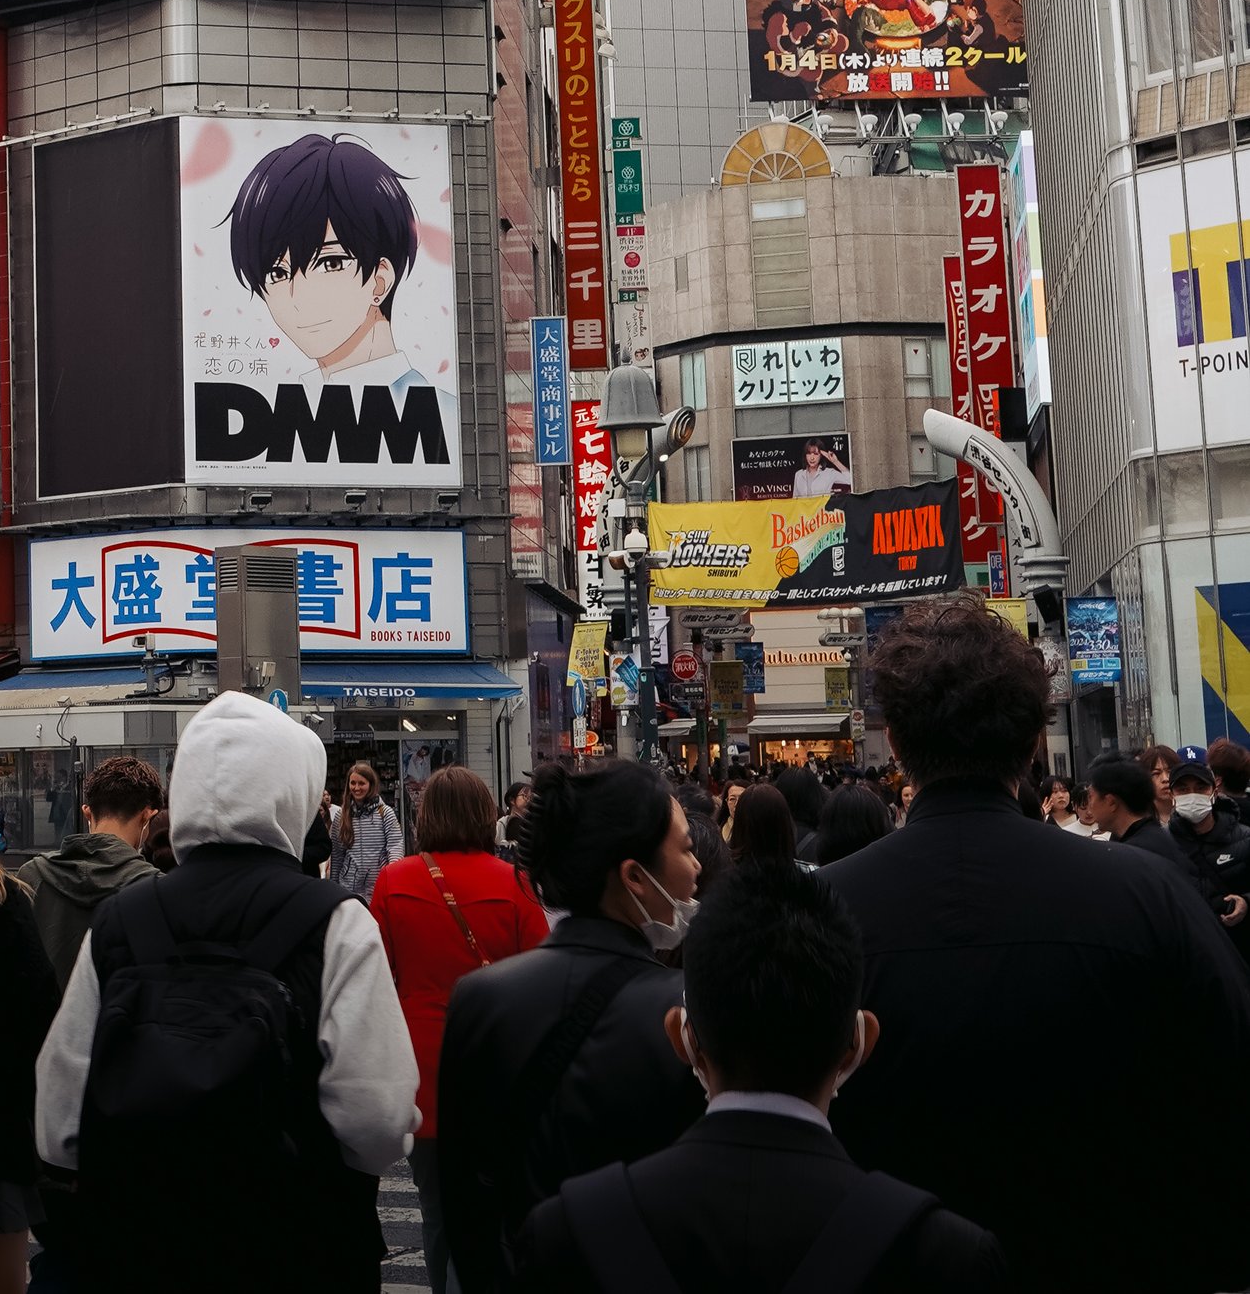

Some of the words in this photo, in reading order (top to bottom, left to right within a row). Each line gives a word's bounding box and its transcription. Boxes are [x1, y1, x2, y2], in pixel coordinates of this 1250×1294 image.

[618, 216, 632, 224] 4F
[964, 189, 1006, 362] カラオケ
[567, 220, 605, 352] 三千里
[623, 293, 635, 301] 3F
[205, 357, 268, 376] 恋の病
[762, 345, 840, 371] れいわ
[540, 326, 562, 458] 大盛堂商事ビル
[738, 374, 841, 402] クリニック
[194, 382, 450, 464] DMM
[753, 485, 765, 494] DA
[768, 484, 792, 493] VINCI
[970, 444, 1032, 542] 渋谷センター街
[687, 530, 712, 543] SUN
[772, 509, 845, 549] Basketball
[872, 505, 945, 555] ALVARK
[707, 569, 738, 578] SHIBUYA
[682, 613, 736, 622] 渋谷センター街
[370, 631, 402, 642] BOOKS
[407, 630, 451, 642] TAISEIDO
[343, 687, 416, 697] TAISEIDO
[1186, 747, 1196, 758] LA
